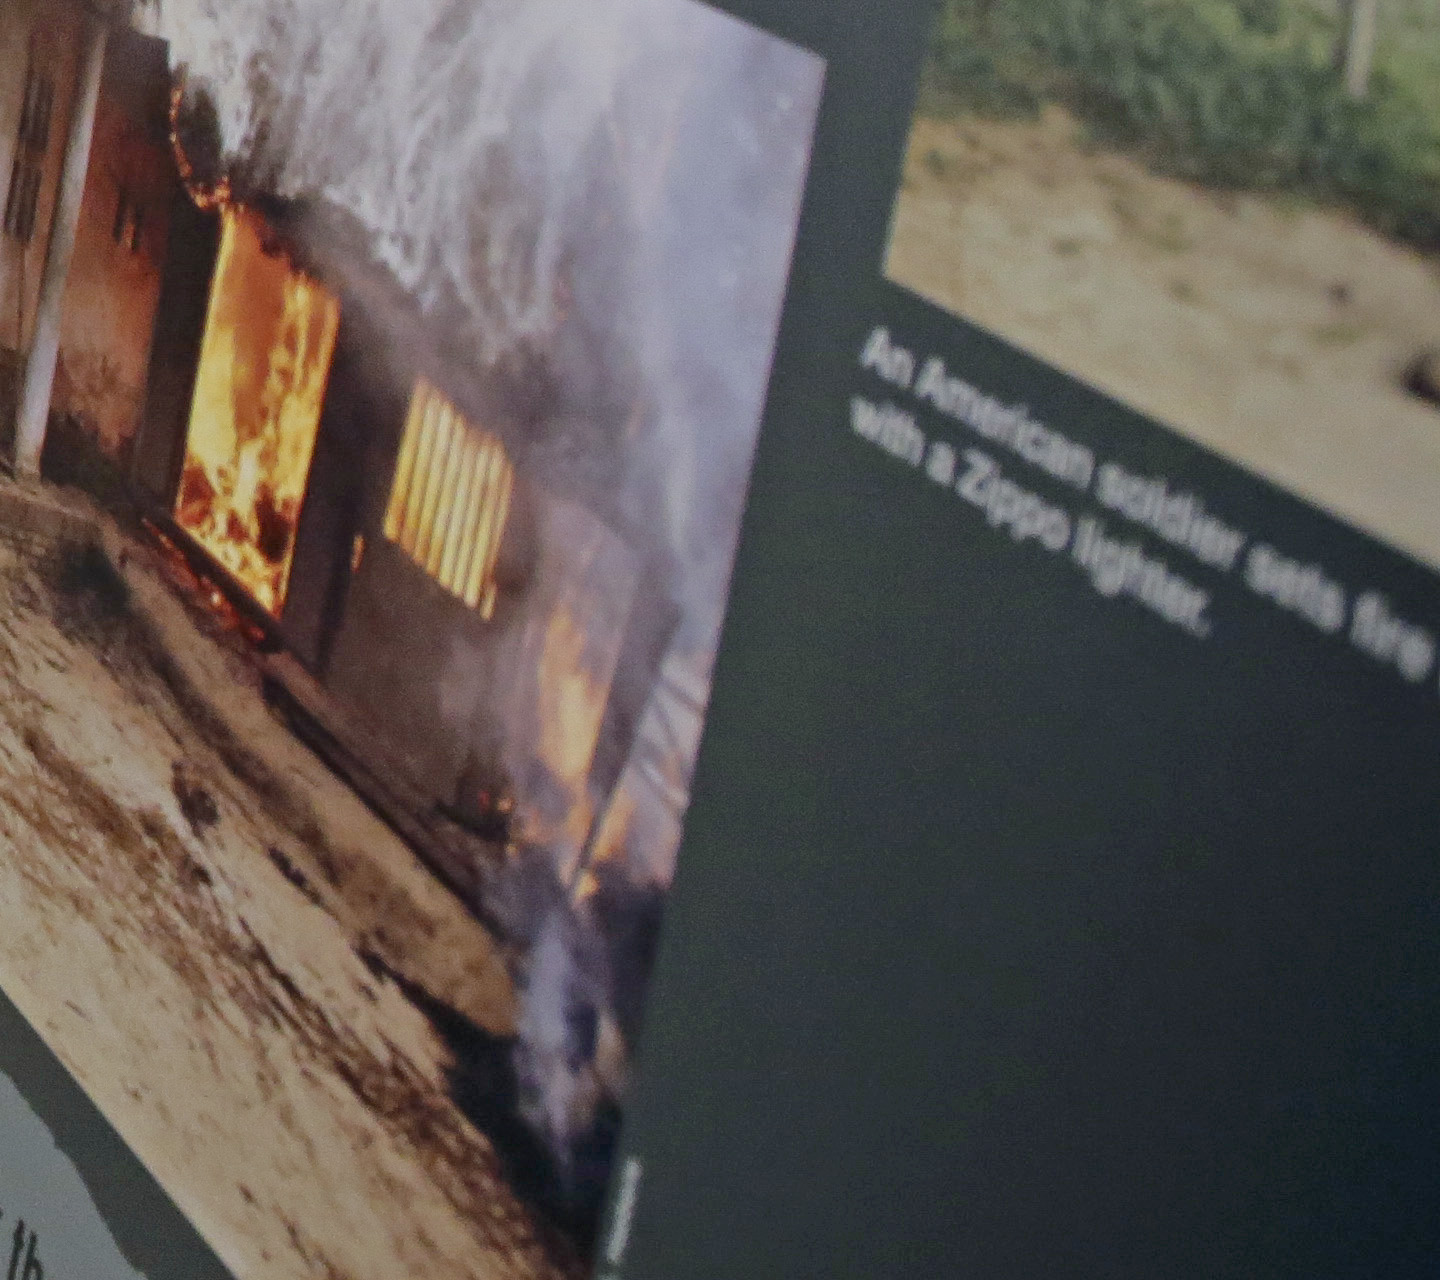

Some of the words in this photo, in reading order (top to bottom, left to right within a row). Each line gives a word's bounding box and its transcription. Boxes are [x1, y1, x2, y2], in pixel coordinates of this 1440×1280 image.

[850, 395, 925, 467] with
[926, 441, 956, 483] a
[956, 447, 1071, 551] Zippo
[860, 325, 915, 389] An
[914, 356, 1095, 490] American
[1094, 462, 1247, 572] soldier
